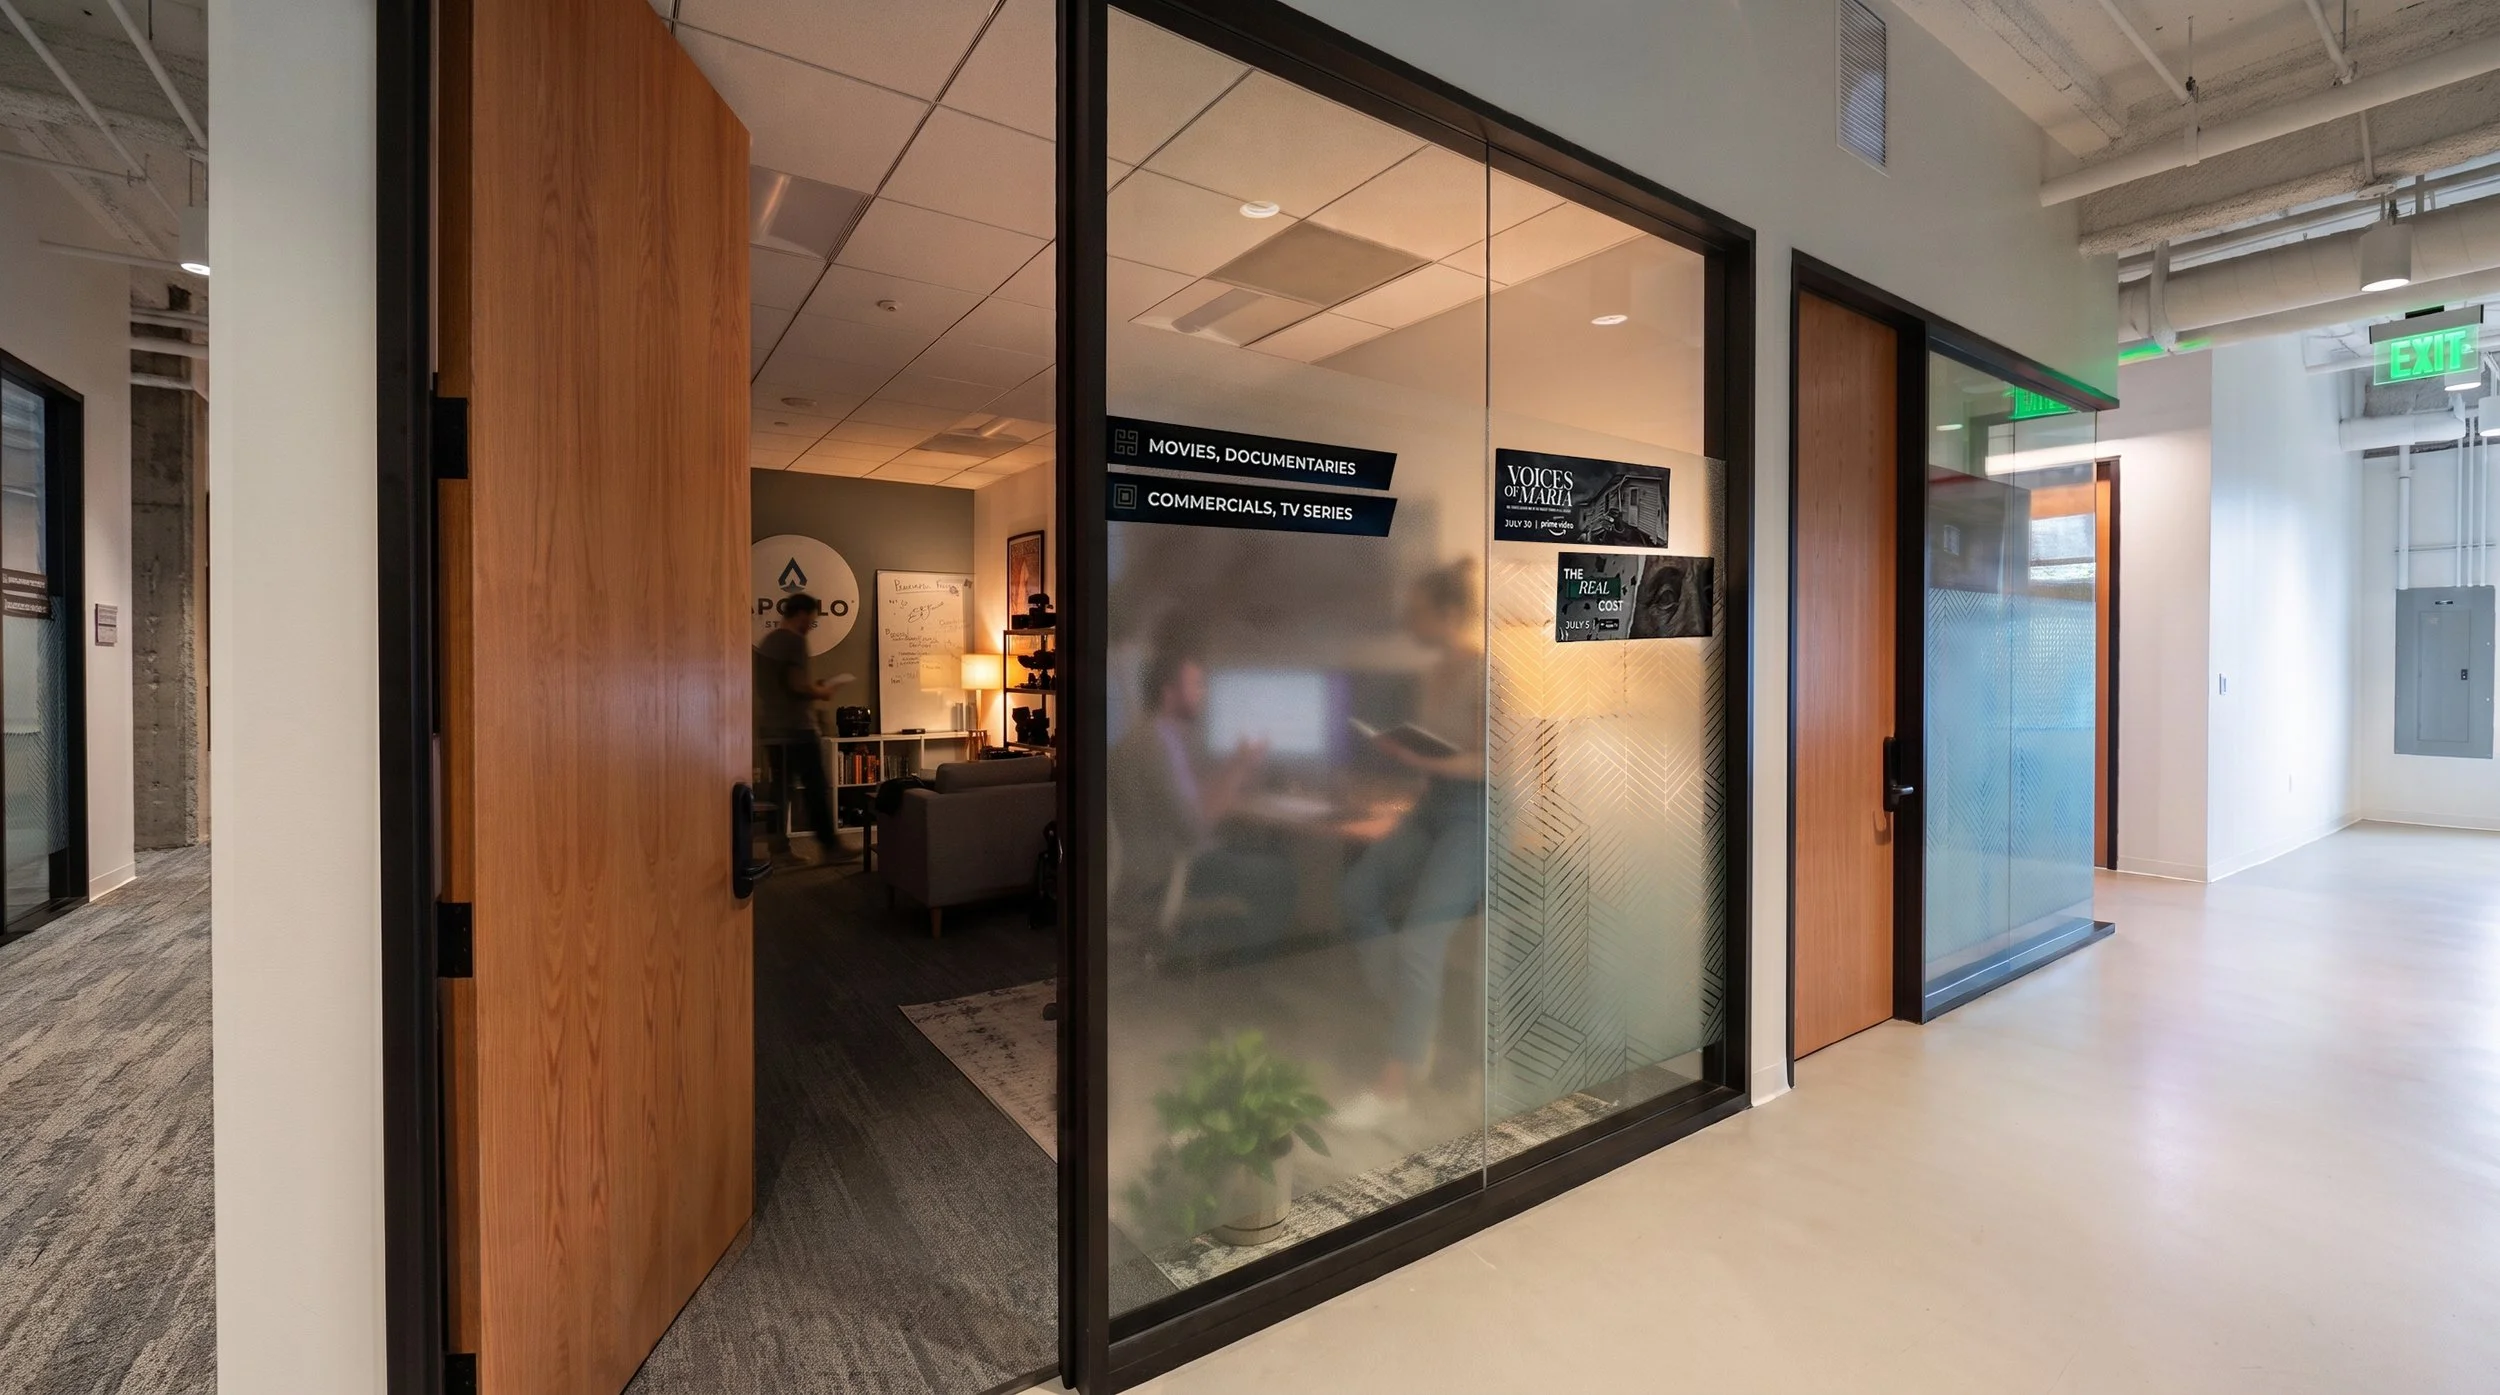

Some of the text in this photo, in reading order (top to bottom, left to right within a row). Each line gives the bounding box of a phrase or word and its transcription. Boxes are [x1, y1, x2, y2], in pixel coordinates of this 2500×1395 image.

[2390, 330, 2466, 378] EXIT
[1149, 438, 1356, 476] MOVIES, DOCUMENTARIES
[1507, 465, 1574, 491] VOICES
[1504, 485, 1573, 507] OF MARIA
[1148, 492, 1353, 521] COMMERCIALS, TV SERIES
[1505, 519, 1574, 529] JULY 30 prime video
[1563, 568, 1584, 580] THE
[1578, 580, 1610, 595] REAL
[1598, 600, 1624, 612] COST
[1565, 620, 1585, 629] JULY
[1585, 620, 1590, 629] 5
